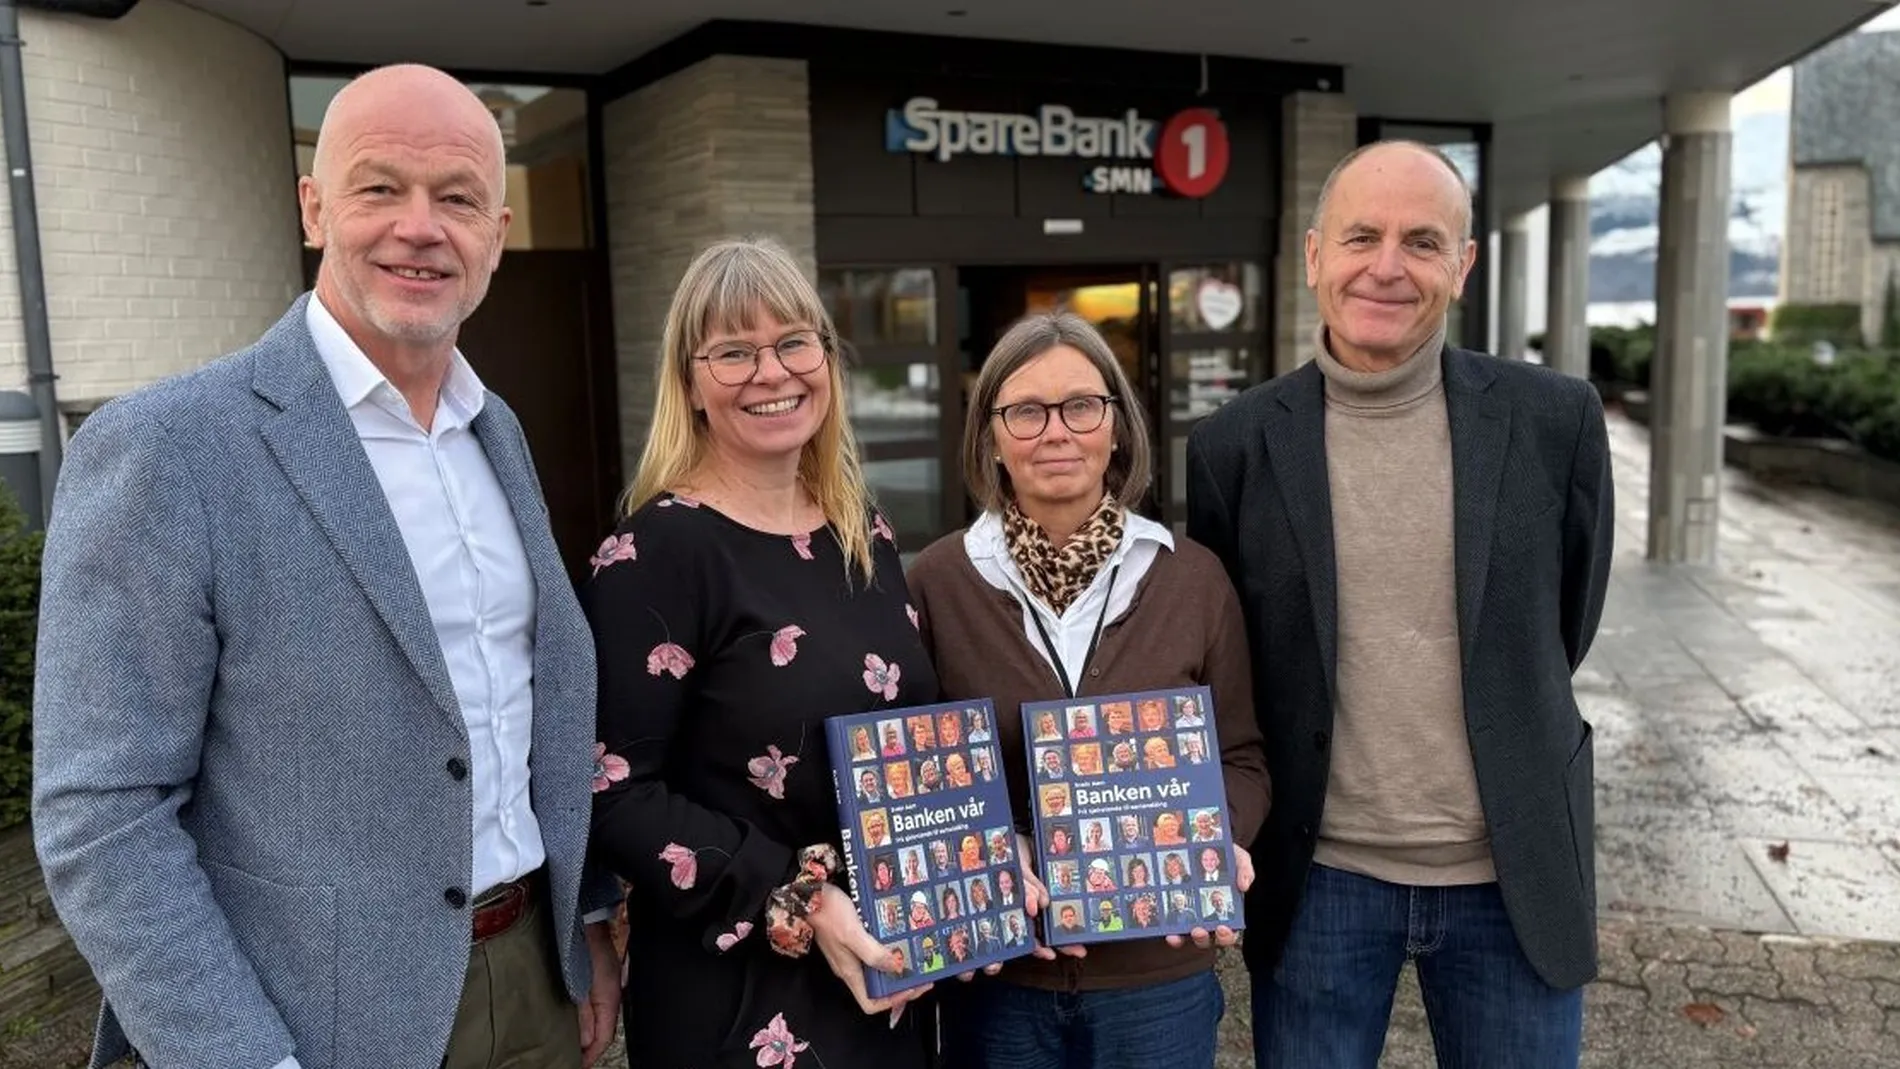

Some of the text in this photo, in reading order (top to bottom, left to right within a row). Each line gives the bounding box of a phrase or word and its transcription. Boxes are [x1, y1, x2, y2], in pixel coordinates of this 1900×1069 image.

[904, 97, 1153, 162] SpareBank
[1092, 166, 1152, 194] SMN
[1076, 784, 1152, 806] Banken
[1157, 777, 1191, 798] vår
[892, 807, 956, 833] Banken
[958, 796, 985, 819] vår
[841, 828, 861, 903] Banken
